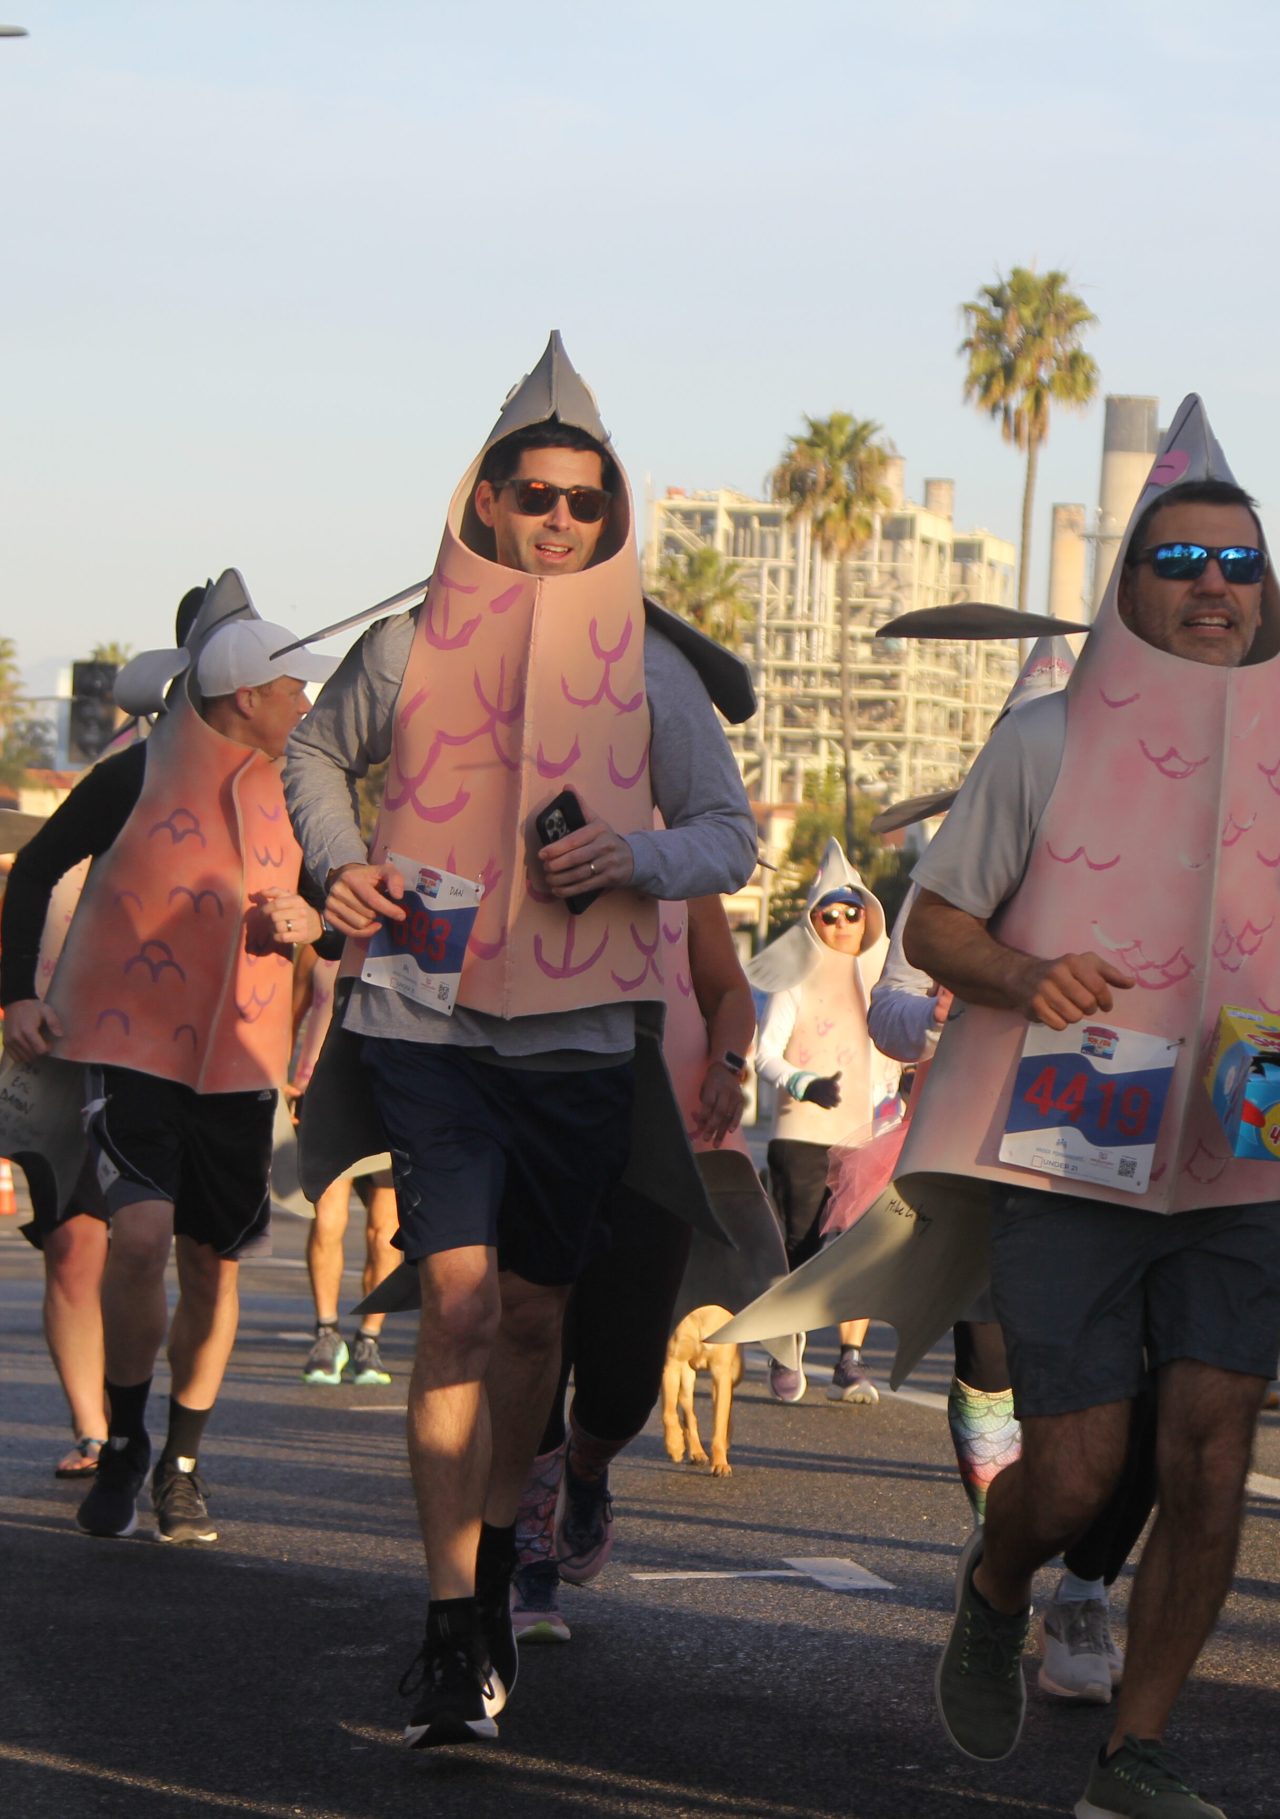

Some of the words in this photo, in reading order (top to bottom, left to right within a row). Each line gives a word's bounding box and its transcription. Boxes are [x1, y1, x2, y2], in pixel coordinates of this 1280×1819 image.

[449, 886, 465, 897] DAN
[1023, 1066, 1152, 1138] 4419
[1043, 1159, 1070, 1170] UNDER
